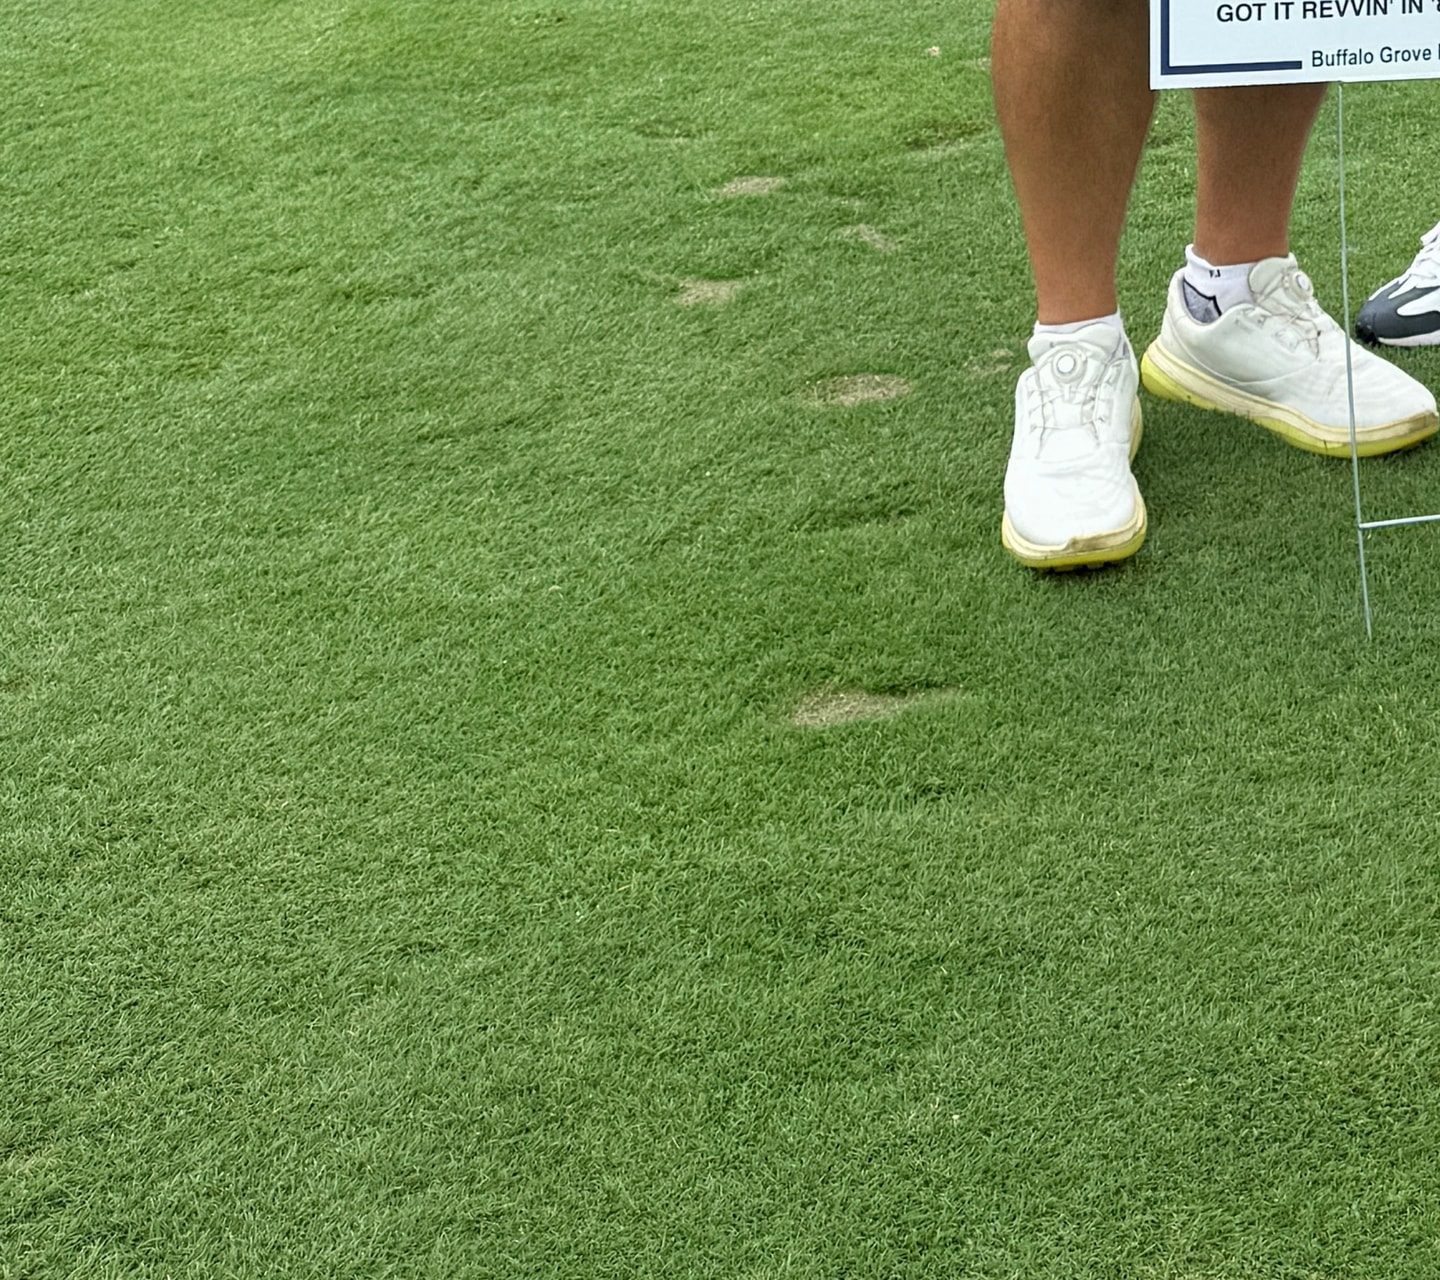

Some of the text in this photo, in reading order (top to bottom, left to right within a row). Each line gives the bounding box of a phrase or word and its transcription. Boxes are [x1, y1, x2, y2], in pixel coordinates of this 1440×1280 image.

[1217, 3, 1267, 22] GOT
[1275, 2, 1294, 20] IT
[1312, 48, 1373, 67] Buffalo
[1380, 46, 1431, 63] Grove
